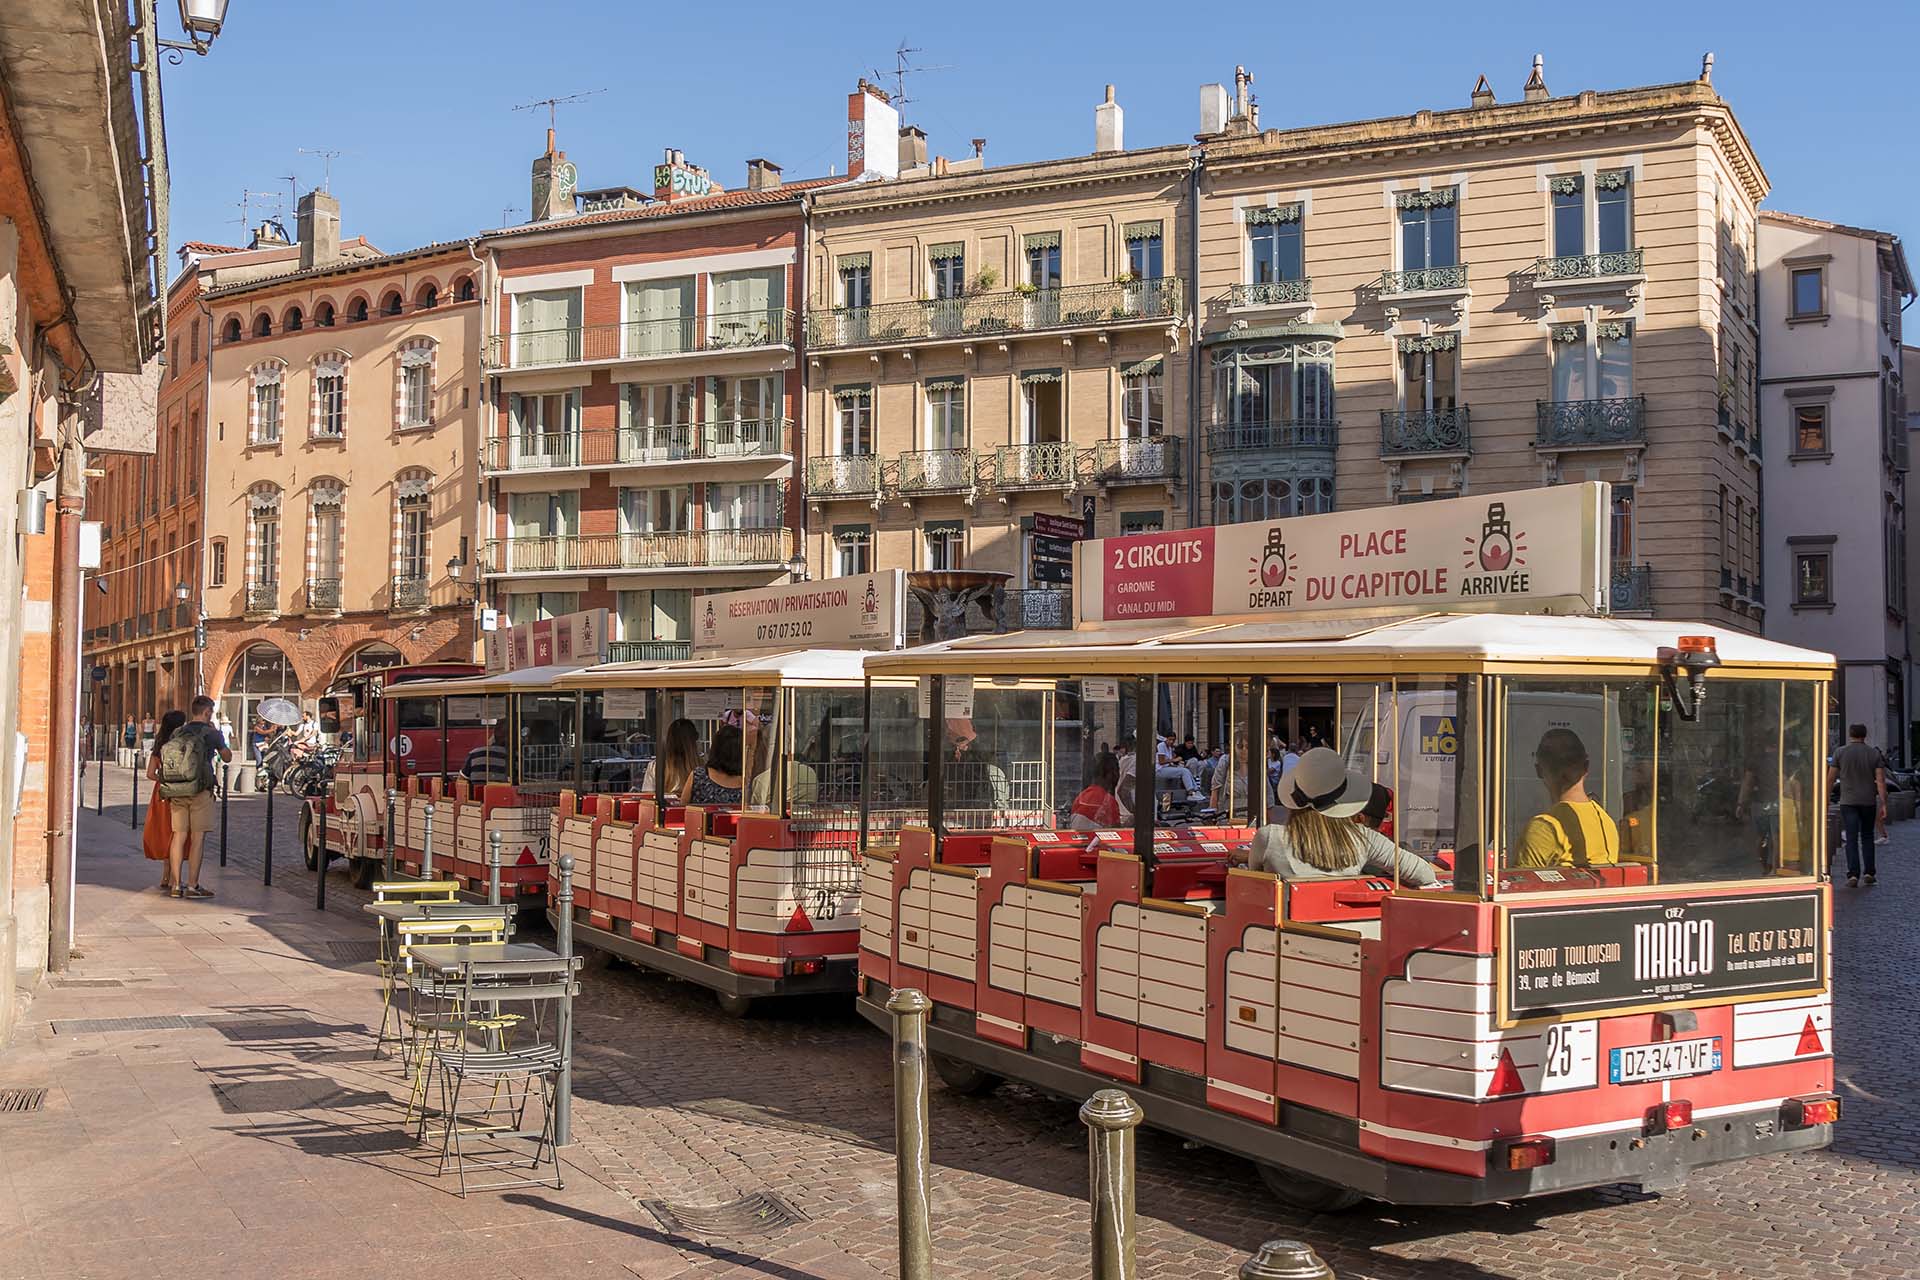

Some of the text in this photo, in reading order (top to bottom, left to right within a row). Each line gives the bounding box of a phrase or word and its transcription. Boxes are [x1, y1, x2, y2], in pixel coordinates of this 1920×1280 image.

[1114, 540, 1202, 570] 2 CIRCUITS
[1340, 529, 1407, 558] PLACE
[1117, 581, 1155, 594] GARONNE
[1306, 568, 1448, 601] DU CAPITOLE
[1460, 571, 1529, 596] ARRIVÉE
[729, 599, 779, 618] RÉSERVATION
[785, 590, 848, 611] PRIVATISATION
[1117, 601, 1175, 614] CANAL DU MIDI
[1249, 589, 1293, 608] DÉPART
[757, 621, 812, 640] 07 67 07 52 02
[815, 891, 836, 921] 25
[1665, 907, 1685, 919] CHEZ
[1634, 919, 1714, 981] MARCO
[1749, 932, 1760, 952] 05
[1763, 931, 1774, 951] 67
[1789, 929, 1800, 949] 58
[1803, 927, 1813, 947] 70
[1519, 942, 1620, 970] BISTROT TOULOUSAIN
[1535, 976, 1549, 989] rue
[1552, 972, 1563, 987] de
[1566, 968, 1600, 986] Rémusat
[1547, 1026, 1572, 1078] 25
[1712, 1052, 1721, 1067] 31
